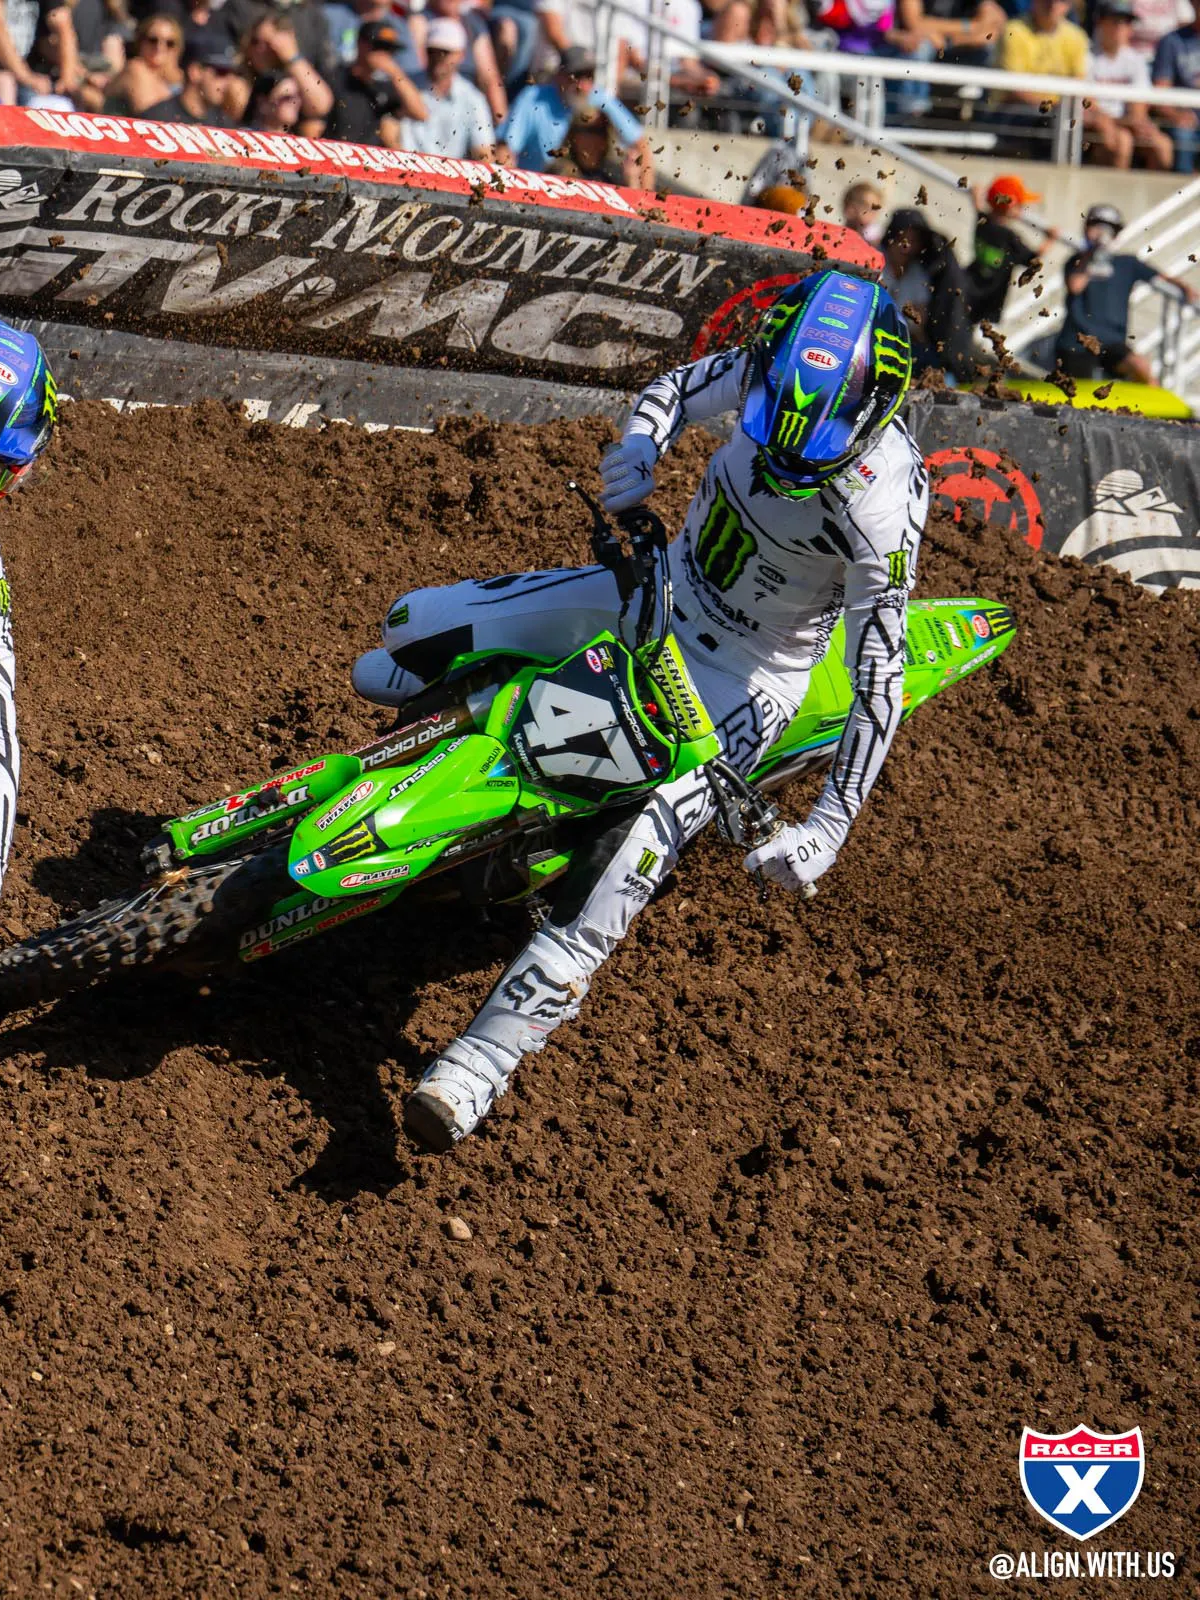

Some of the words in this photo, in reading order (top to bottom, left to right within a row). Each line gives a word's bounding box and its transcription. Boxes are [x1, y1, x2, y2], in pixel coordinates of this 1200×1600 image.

[57, 168, 324, 241] ROCKY
[312, 195, 728, 299] MOUNTAIN
[806, 350, 833, 367] BELL
[650, 663, 689, 734] ENTHAL
[662, 644, 704, 731] RENTHAL
[418, 717, 458, 740] PRO
[522, 678, 648, 785] 47
[609, 674, 648, 748] SUPERCROSS
[446, 735, 471, 752] PRO
[479, 746, 502, 776] KITCHEN
[513, 732, 541, 781] Kawasaki
[260, 760, 327, 793] BRAKING
[388, 751, 447, 801] CIRCUIT
[484, 780, 517, 789] KITCHEN
[785, 838, 822, 871] FOX
